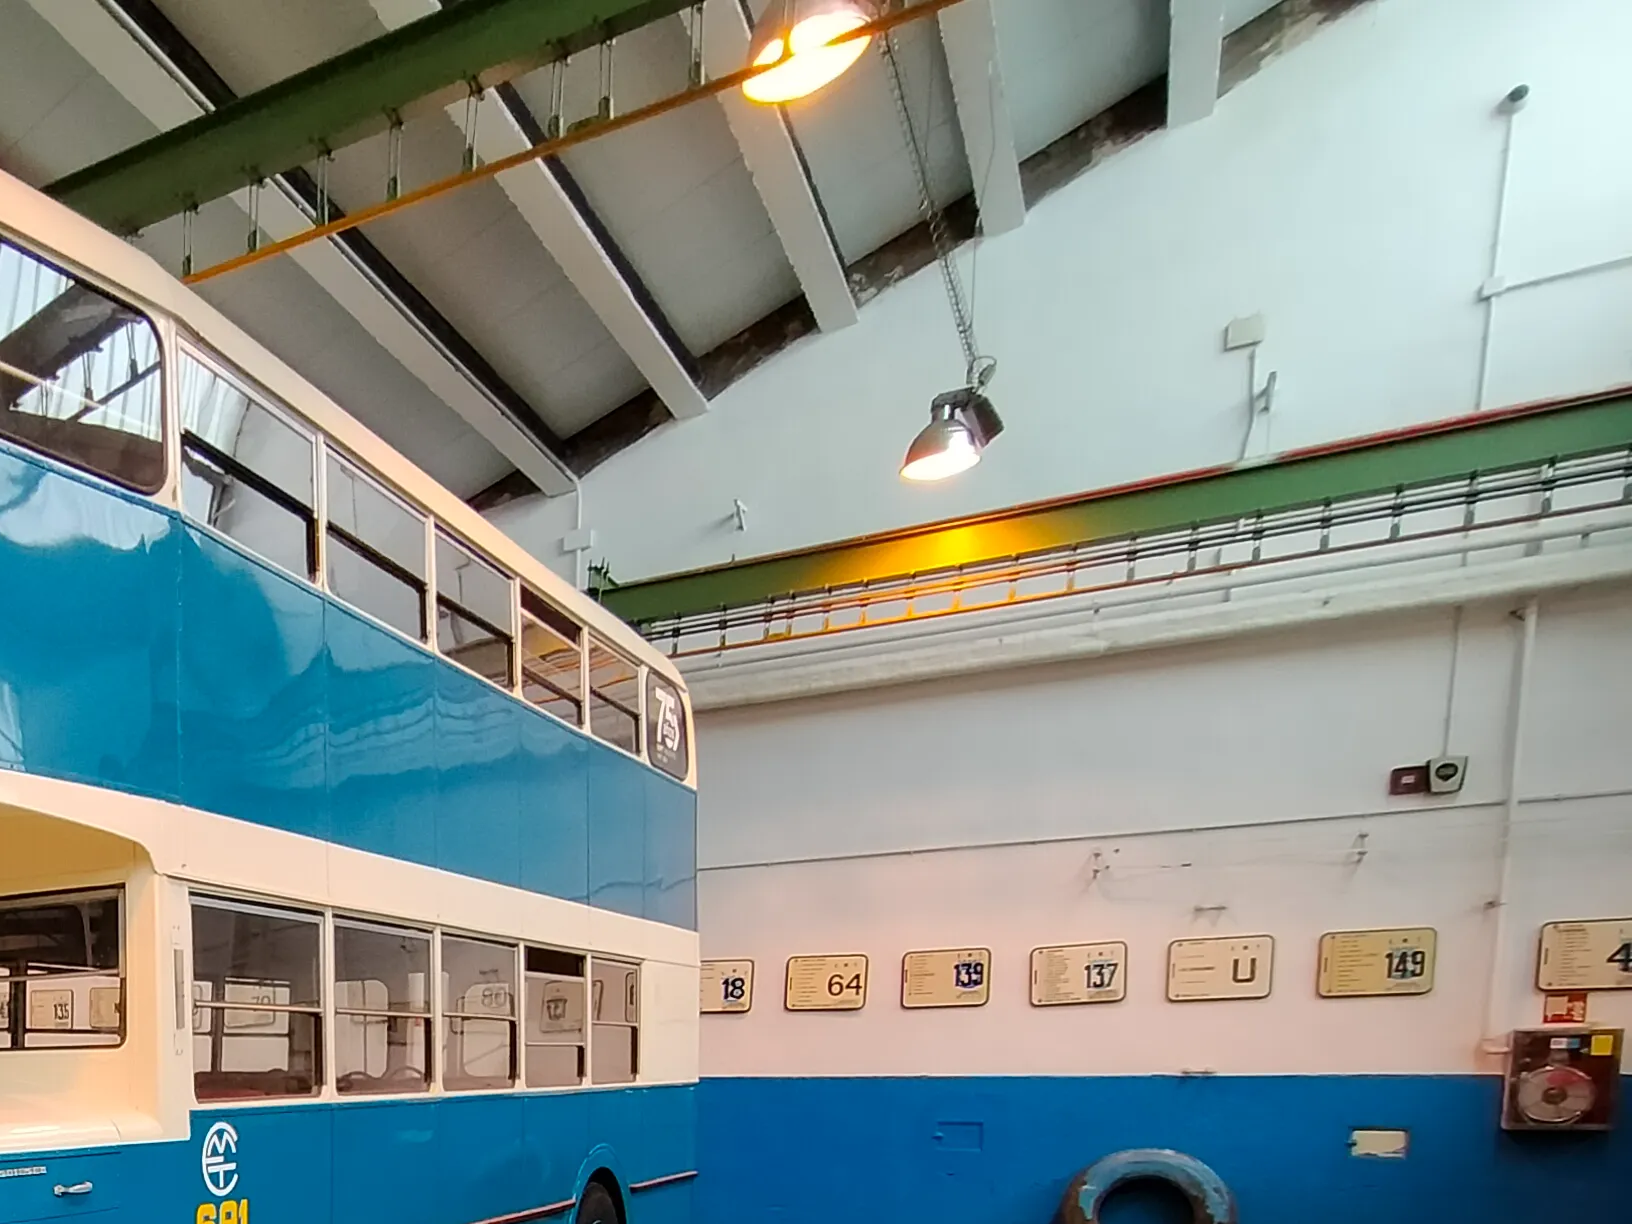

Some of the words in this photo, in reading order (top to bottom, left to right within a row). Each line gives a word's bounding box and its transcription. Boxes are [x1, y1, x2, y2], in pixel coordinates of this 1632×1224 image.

[954, 962, 984, 988] 139
[1084, 962, 1119, 989] 137
[1232, 957, 1257, 983] U
[1385, 950, 1426, 979] 149
[827, 973, 863, 997] 64
